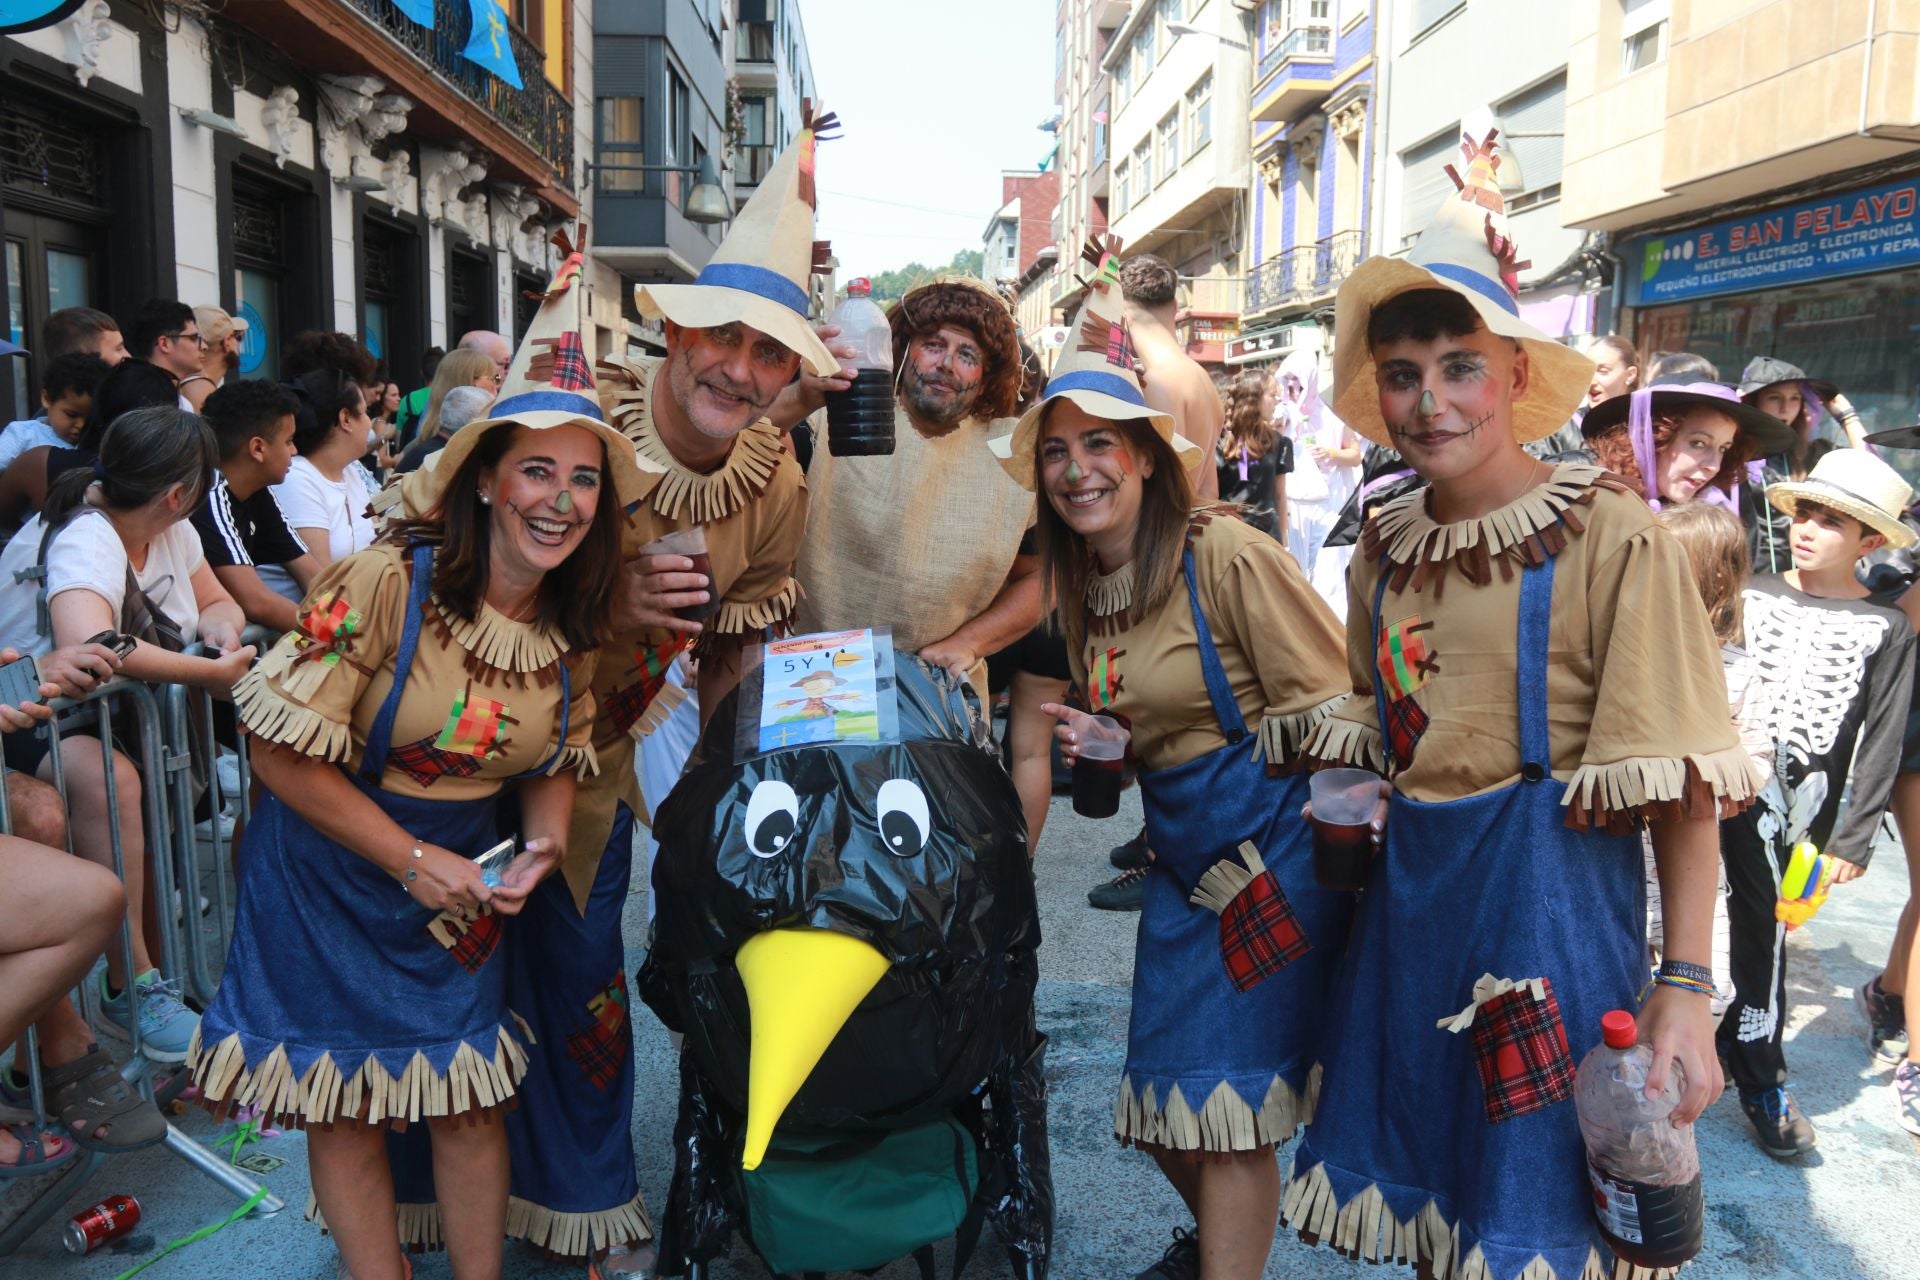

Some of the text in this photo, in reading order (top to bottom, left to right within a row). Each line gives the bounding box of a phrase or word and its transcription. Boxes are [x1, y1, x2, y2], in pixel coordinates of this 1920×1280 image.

[1697, 187, 1915, 258] E. SAN PELAYO
[1694, 222, 1913, 272] MATERIAL ELECTRICO ELECTRONICA
[1654, 275, 1699, 292] PEQUEÑO
[1701, 255, 1814, 285] ELECTRODOMESTICO
[1825, 247, 1866, 264] VENTA
[1869, 244, 1879, 256] Y
[1193, 331, 1236, 341] TRELLES
[1194, 320, 1212, 328] CASA
[784, 656, 814, 673] 5 Y
